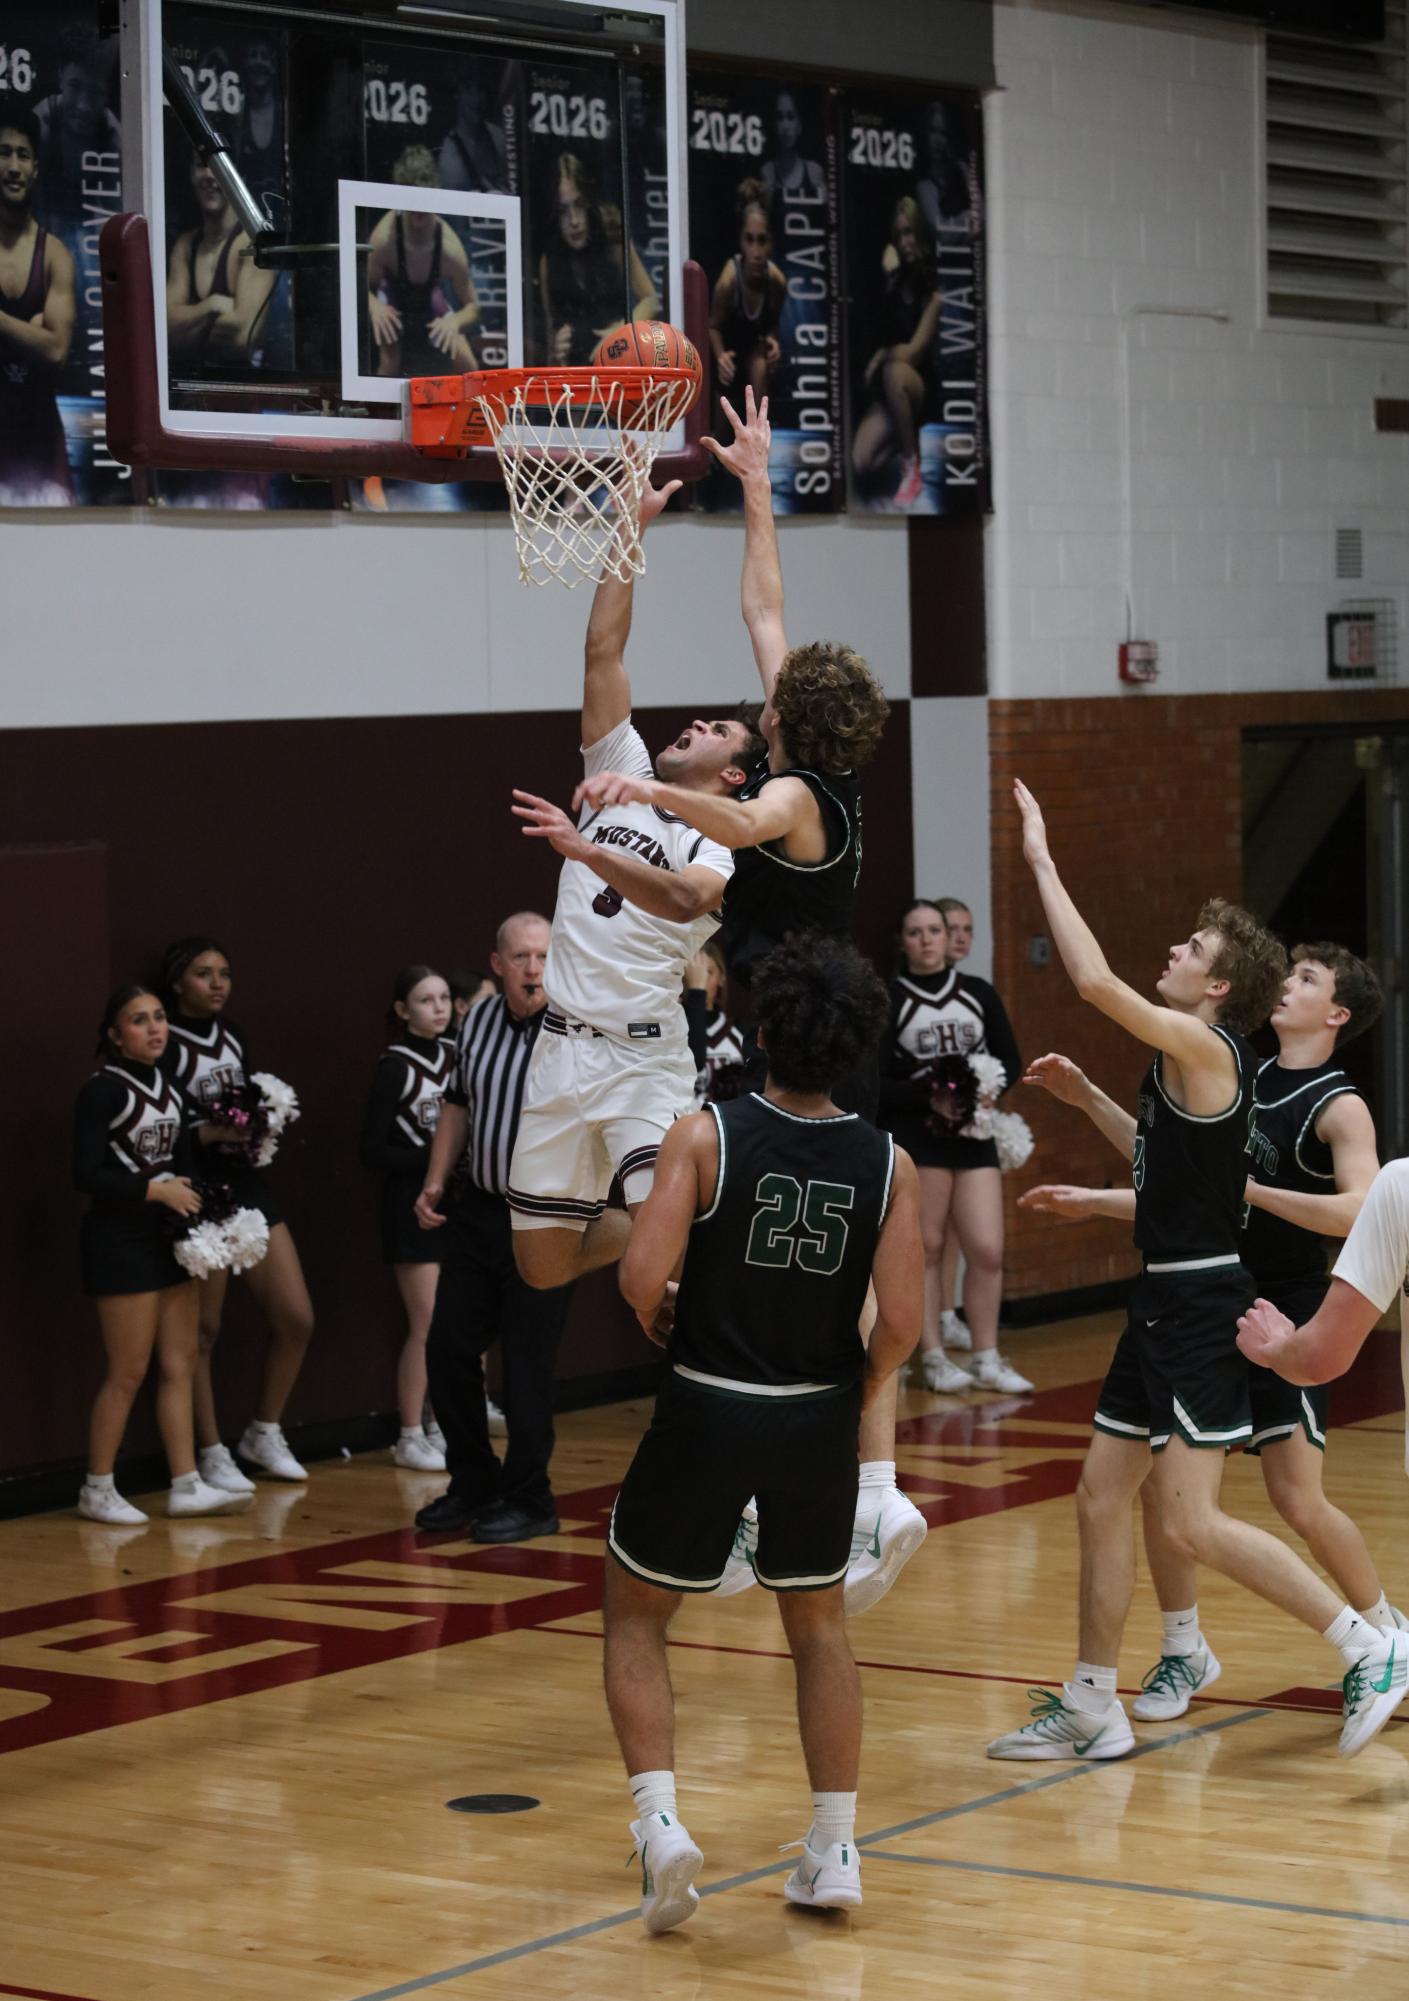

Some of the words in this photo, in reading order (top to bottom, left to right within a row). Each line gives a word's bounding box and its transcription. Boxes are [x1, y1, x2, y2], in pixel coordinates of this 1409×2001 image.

[364, 79, 429, 125] 026
[530, 91, 609, 140] 2026
[691, 109, 764, 156] 2026
[826, 134, 838, 224] WRESTLING
[851, 127, 915, 170] 2026
[783, 182, 828, 301] CAPE
[828, 232, 840, 298] SCHOOL
[936, 215, 977, 356] WAITE
[791, 322, 831, 496] Sophia
[942, 380, 977, 487] KODI
[915, 1020, 976, 1054] CHS
[744, 1172, 856, 1276] 25
